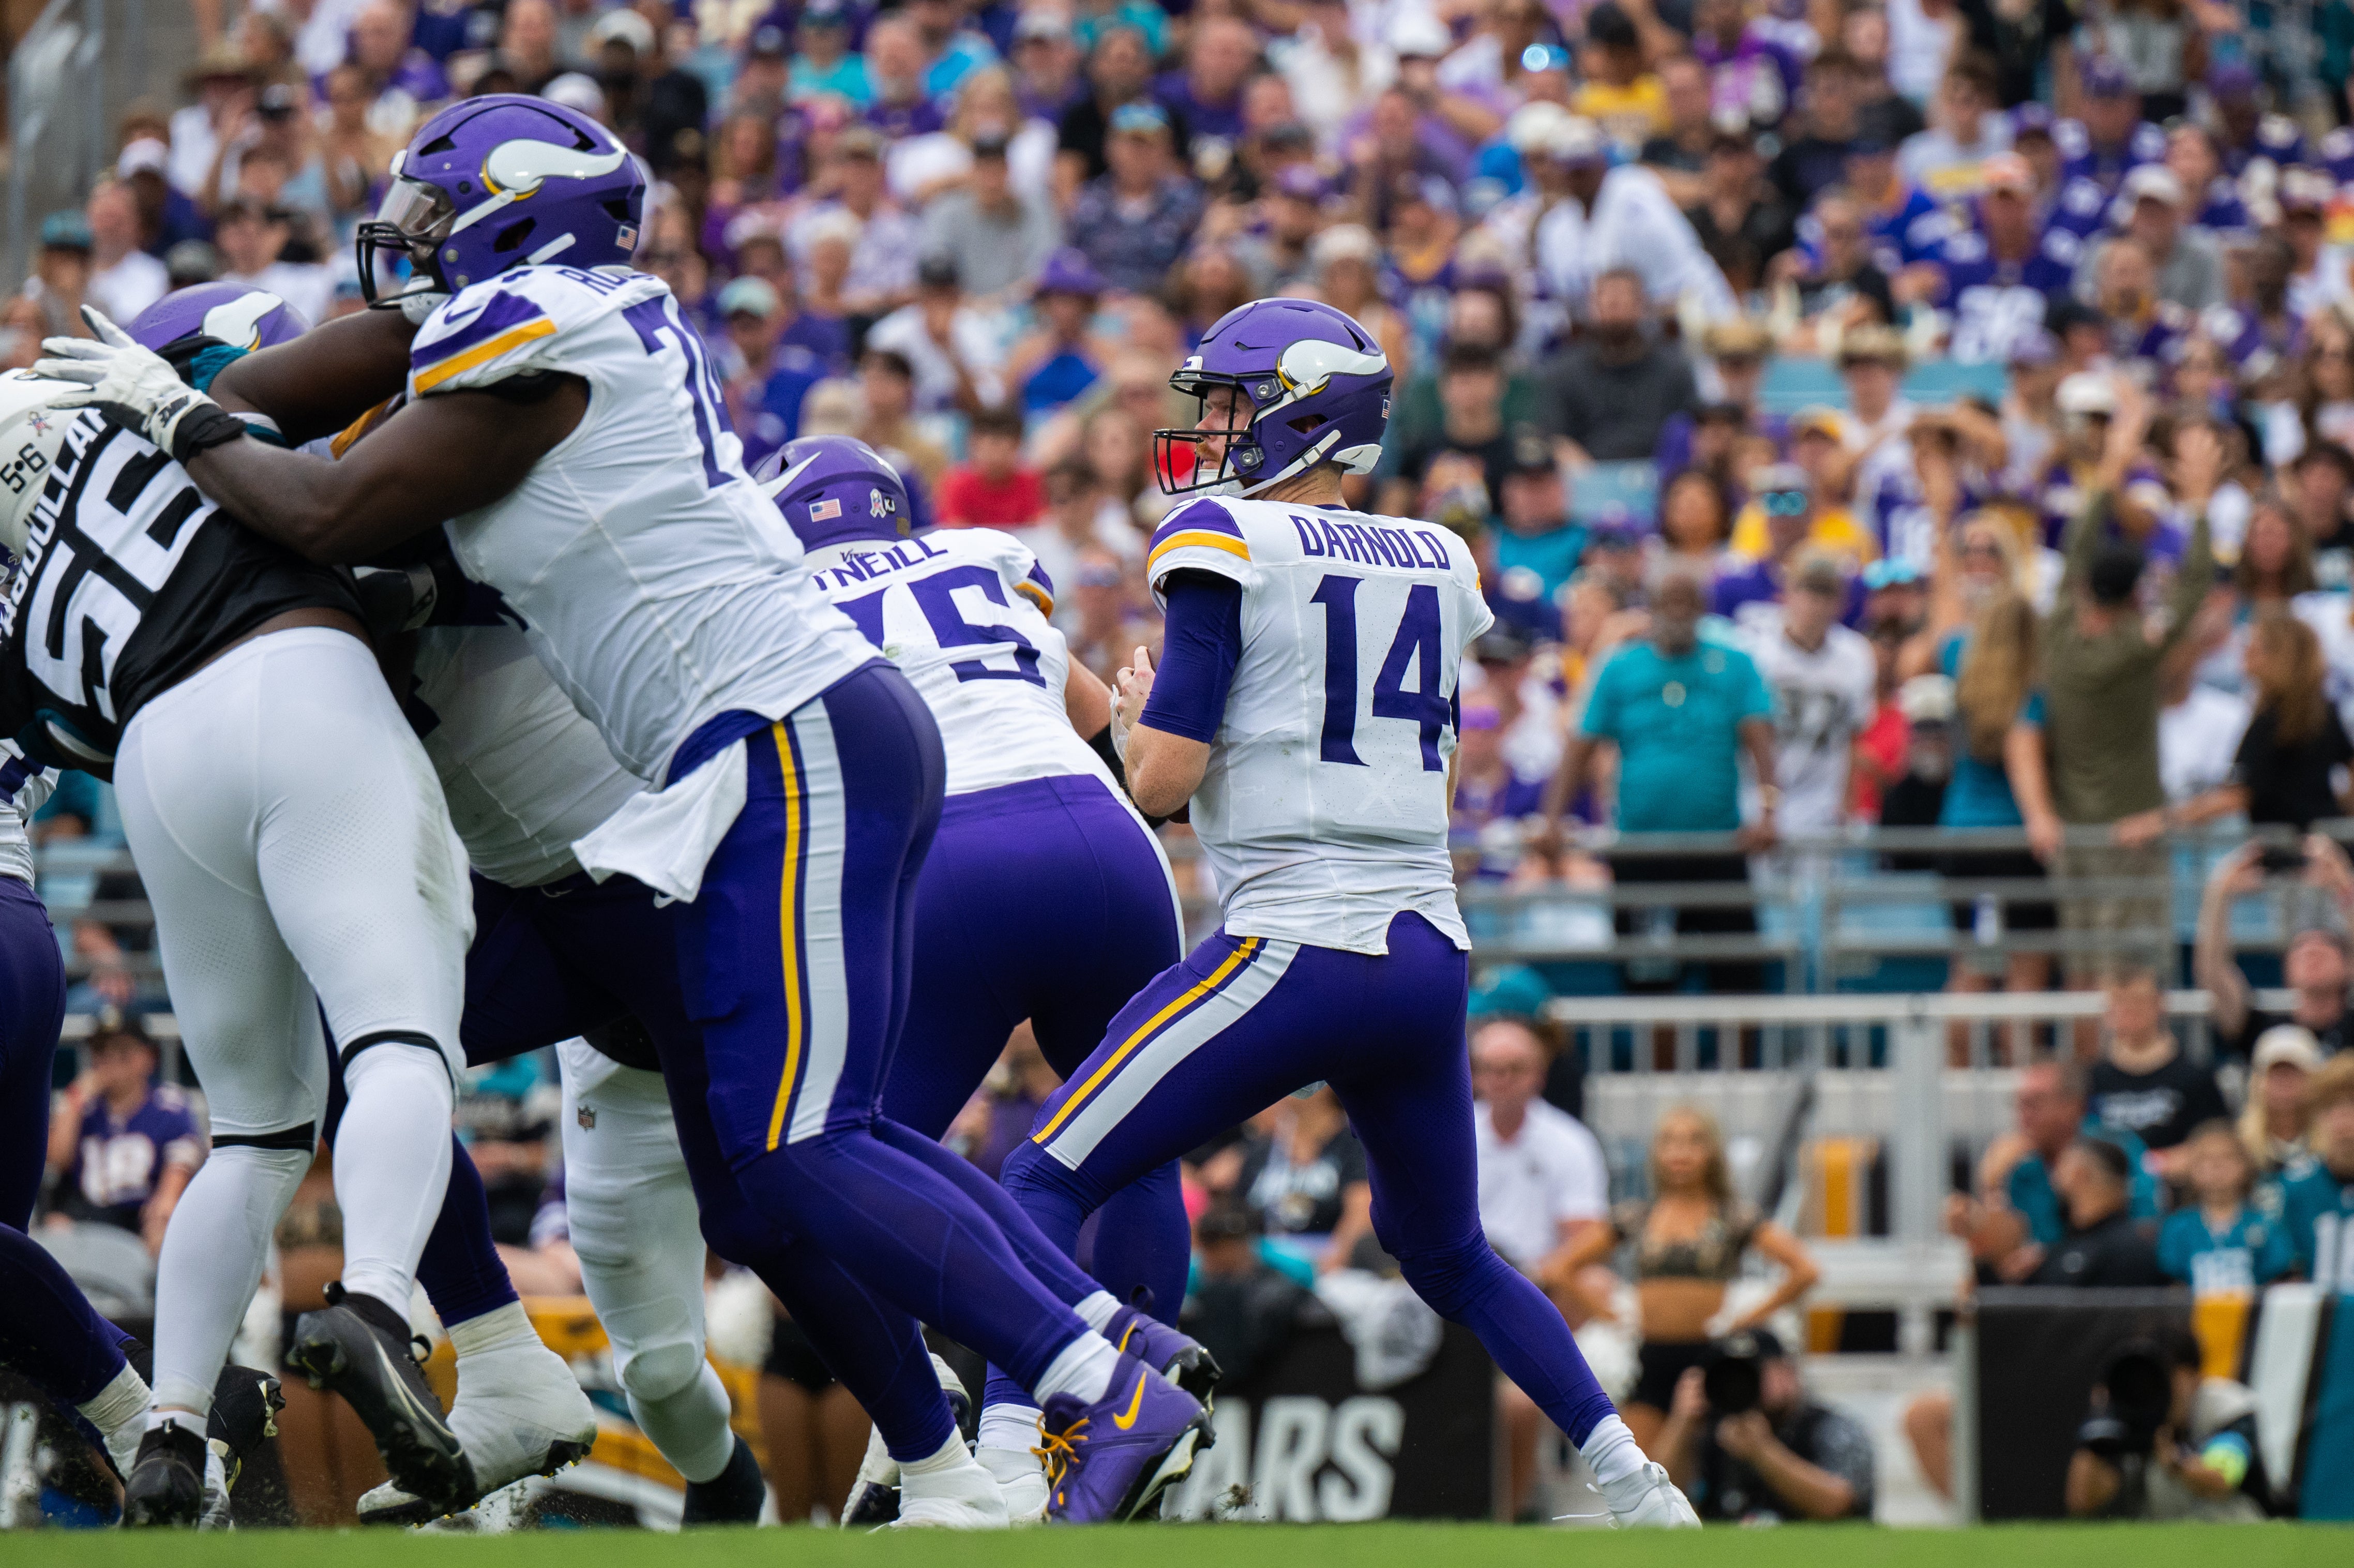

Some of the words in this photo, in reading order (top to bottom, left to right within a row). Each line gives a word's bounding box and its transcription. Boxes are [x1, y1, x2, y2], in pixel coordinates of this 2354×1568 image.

[26, 427, 221, 723] 56
[1288, 515, 1451, 570] DARNOLD
[832, 565, 1047, 689] 75
[1309, 574, 1452, 773] 14
